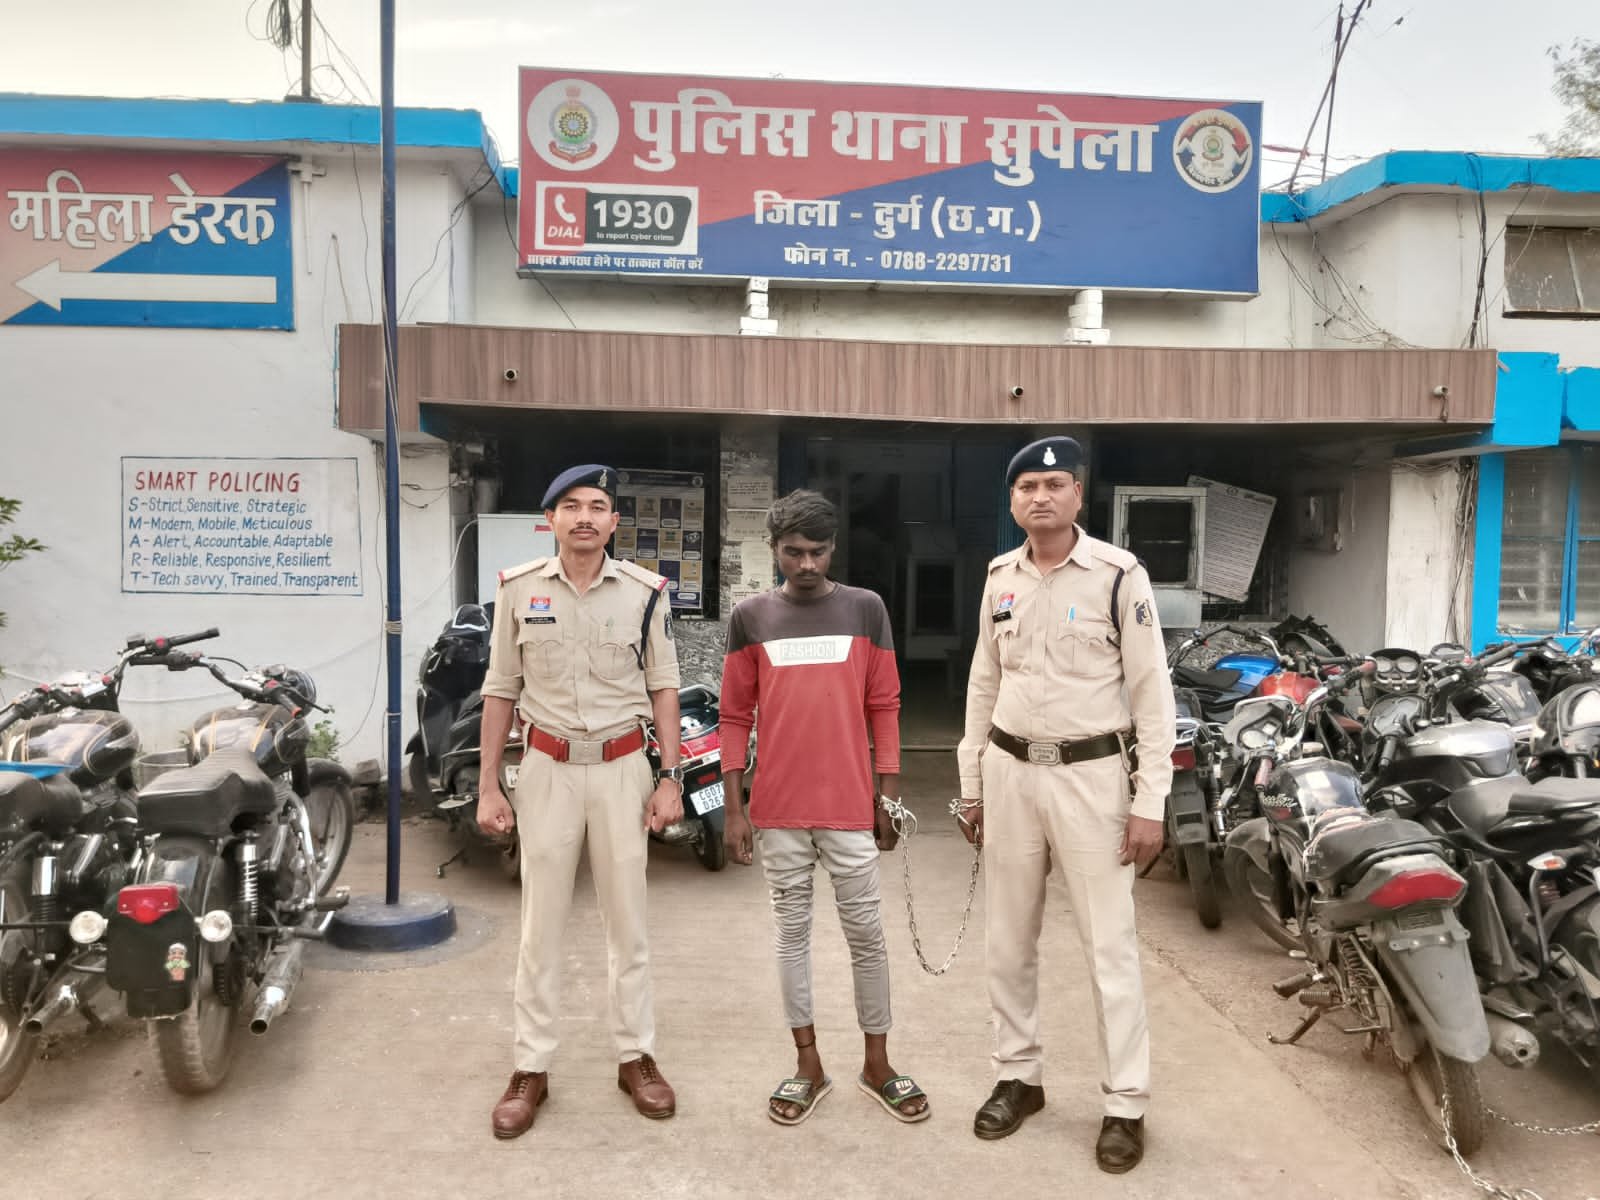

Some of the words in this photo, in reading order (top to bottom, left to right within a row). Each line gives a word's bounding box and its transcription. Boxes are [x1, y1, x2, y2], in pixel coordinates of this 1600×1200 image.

[630, 88, 815, 172] पुलिस
[831, 110, 968, 164] थाना
[983, 104, 1159, 187] सुपेला
[7, 169, 154, 249] महिला
[593, 199, 675, 231] 1930
[753, 189, 841, 227] जिला
[873, 194, 924, 240] दुर्ग
[931, 196, 1042, 242] (छ.ग.)
[547, 225, 582, 239] DIAL
[606, 232, 629, 240] report
[630, 232, 652, 241] cyber
[653, 233, 675, 241] crime
[614, 256, 626, 268] पर
[784, 242, 828, 265] फोन
[880, 250, 1012, 273] 0788-2297731
[135, 471, 199, 492] SMART
[208, 471, 301, 493] POLICING
[246, 498, 307, 517] Strategic
[242, 516, 313, 530] Meticulous
[273, 533, 334, 550] Adaptable
[276, 552, 333, 567] Resilient
[281, 571, 359, 591] Transparent
[783, 641, 836, 658] FASHION
[699, 783, 723, 800] CG07
